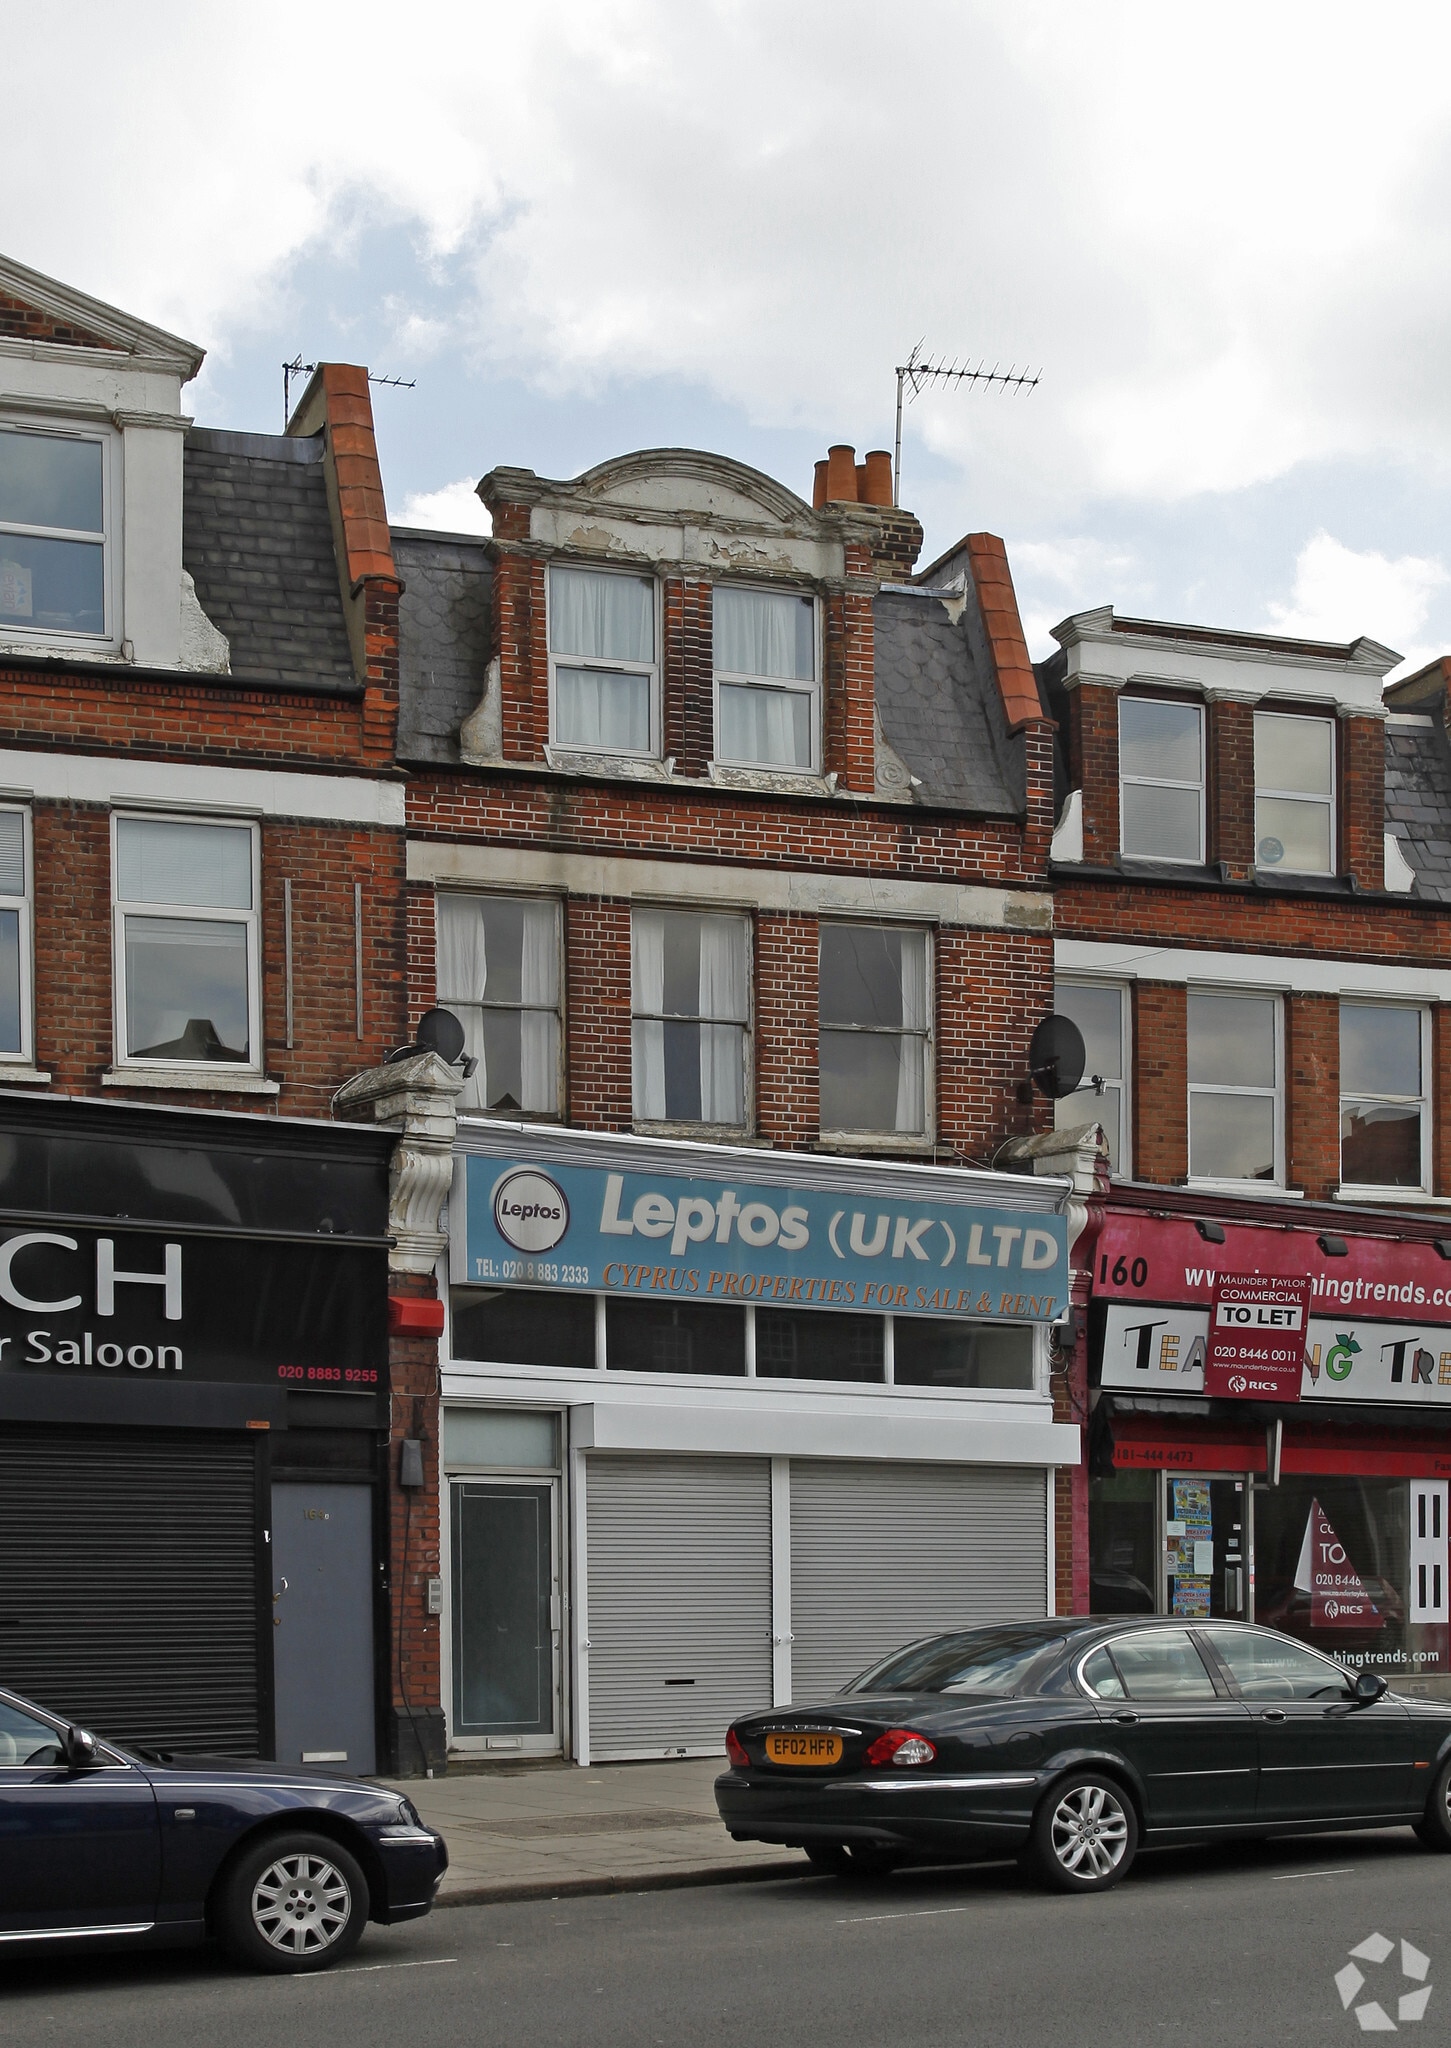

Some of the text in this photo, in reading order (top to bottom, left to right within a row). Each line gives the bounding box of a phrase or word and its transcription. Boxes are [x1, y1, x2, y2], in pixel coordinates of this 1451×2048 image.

[501, 1199, 561, 1221] Leptos
[600, 1174, 1059, 1270] Leptos (UK) LTD
[476, 1258, 589, 1285] TEL: 020 8 883 2333
[1100, 1254, 1148, 1288] 160
[603, 1262, 1057, 1317] CYPRUS PROPERTIES FOR SALE & RENT
[1270, 1278, 1306, 1289] TAYLOR
[1220, 1289, 1303, 1303] COMMERCIAL
[1223, 1306, 1297, 1326] TO LET
[25, 1331, 183, 1370] Saloon
[1214, 1346, 1297, 1362] 020 8446 0011
[278, 1365, 378, 1382] 020 8883 9255
[1213, 1362, 1296, 1373] www.maundertaylor.co.uk
[1248, 1381, 1278, 1391] RICS
[1320, 1543, 1346, 1564] TO
[1316, 1574, 1333, 1585] 020
[1340, 1605, 1363, 1615] RICS
[774, 1739, 835, 1756] EF02 HFR
